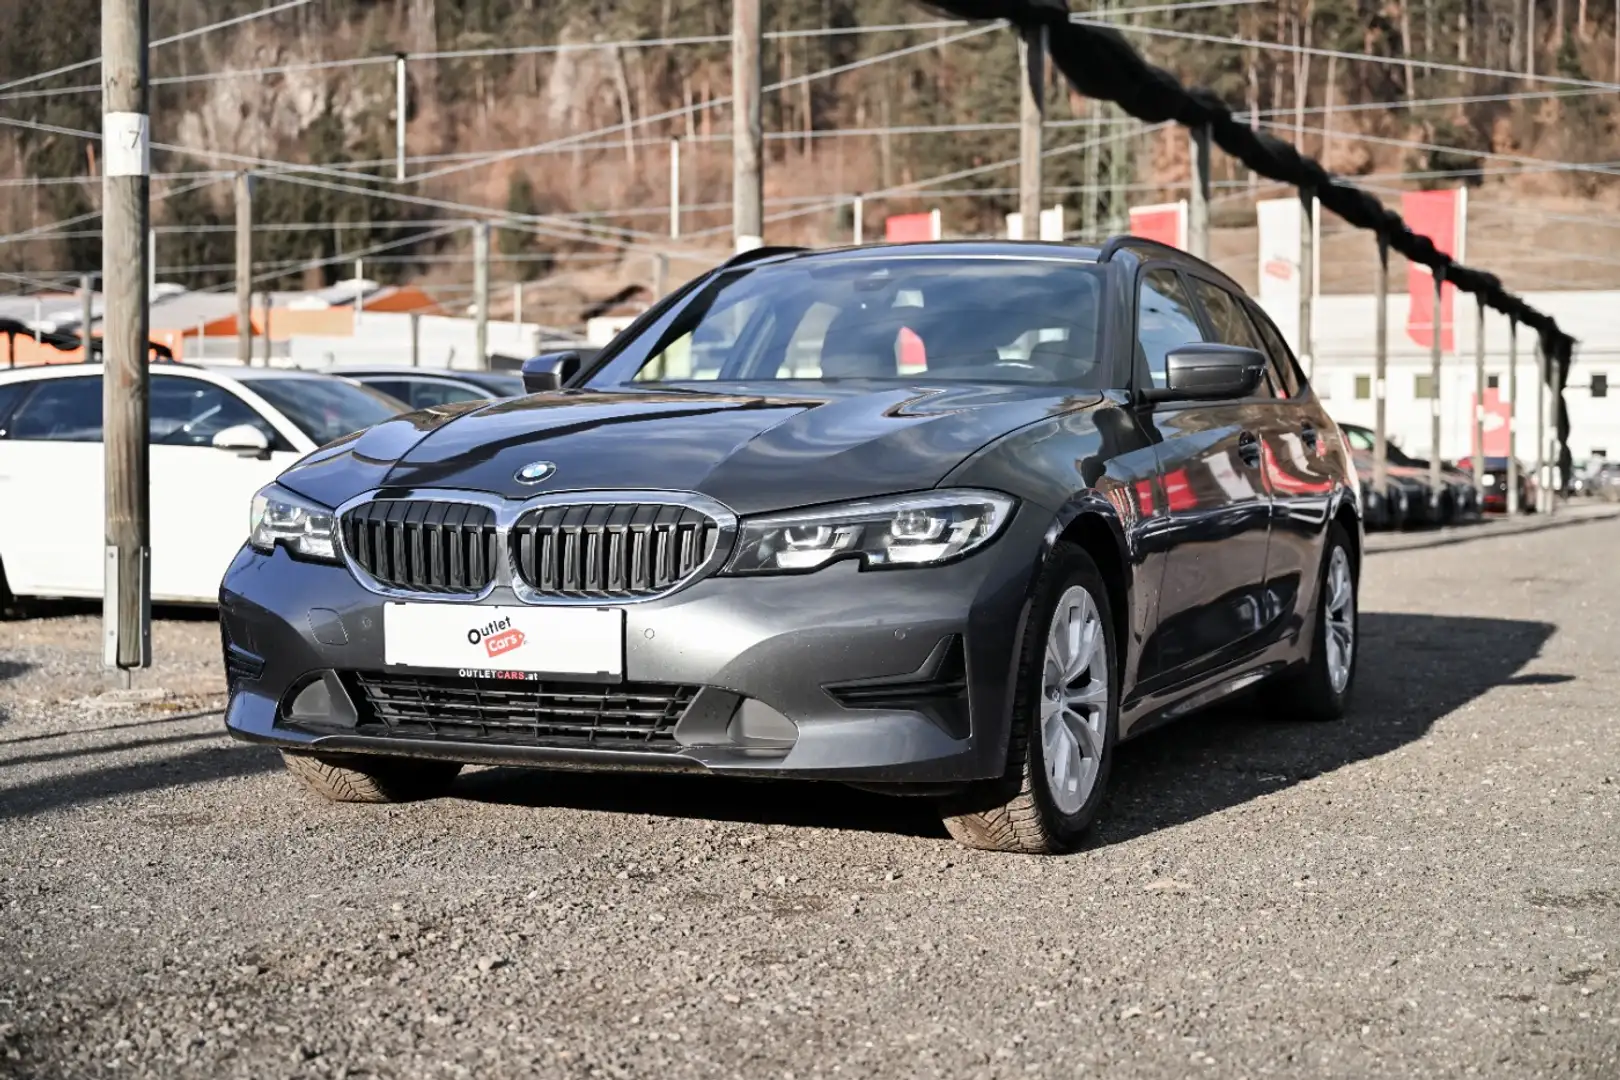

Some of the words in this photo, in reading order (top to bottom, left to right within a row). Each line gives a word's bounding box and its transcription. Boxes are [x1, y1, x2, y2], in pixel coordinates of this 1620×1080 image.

[467, 616, 511, 645] Outlet
[488, 634, 518, 652] Cars
[458, 668, 538, 681] OUTLETCARS.at
